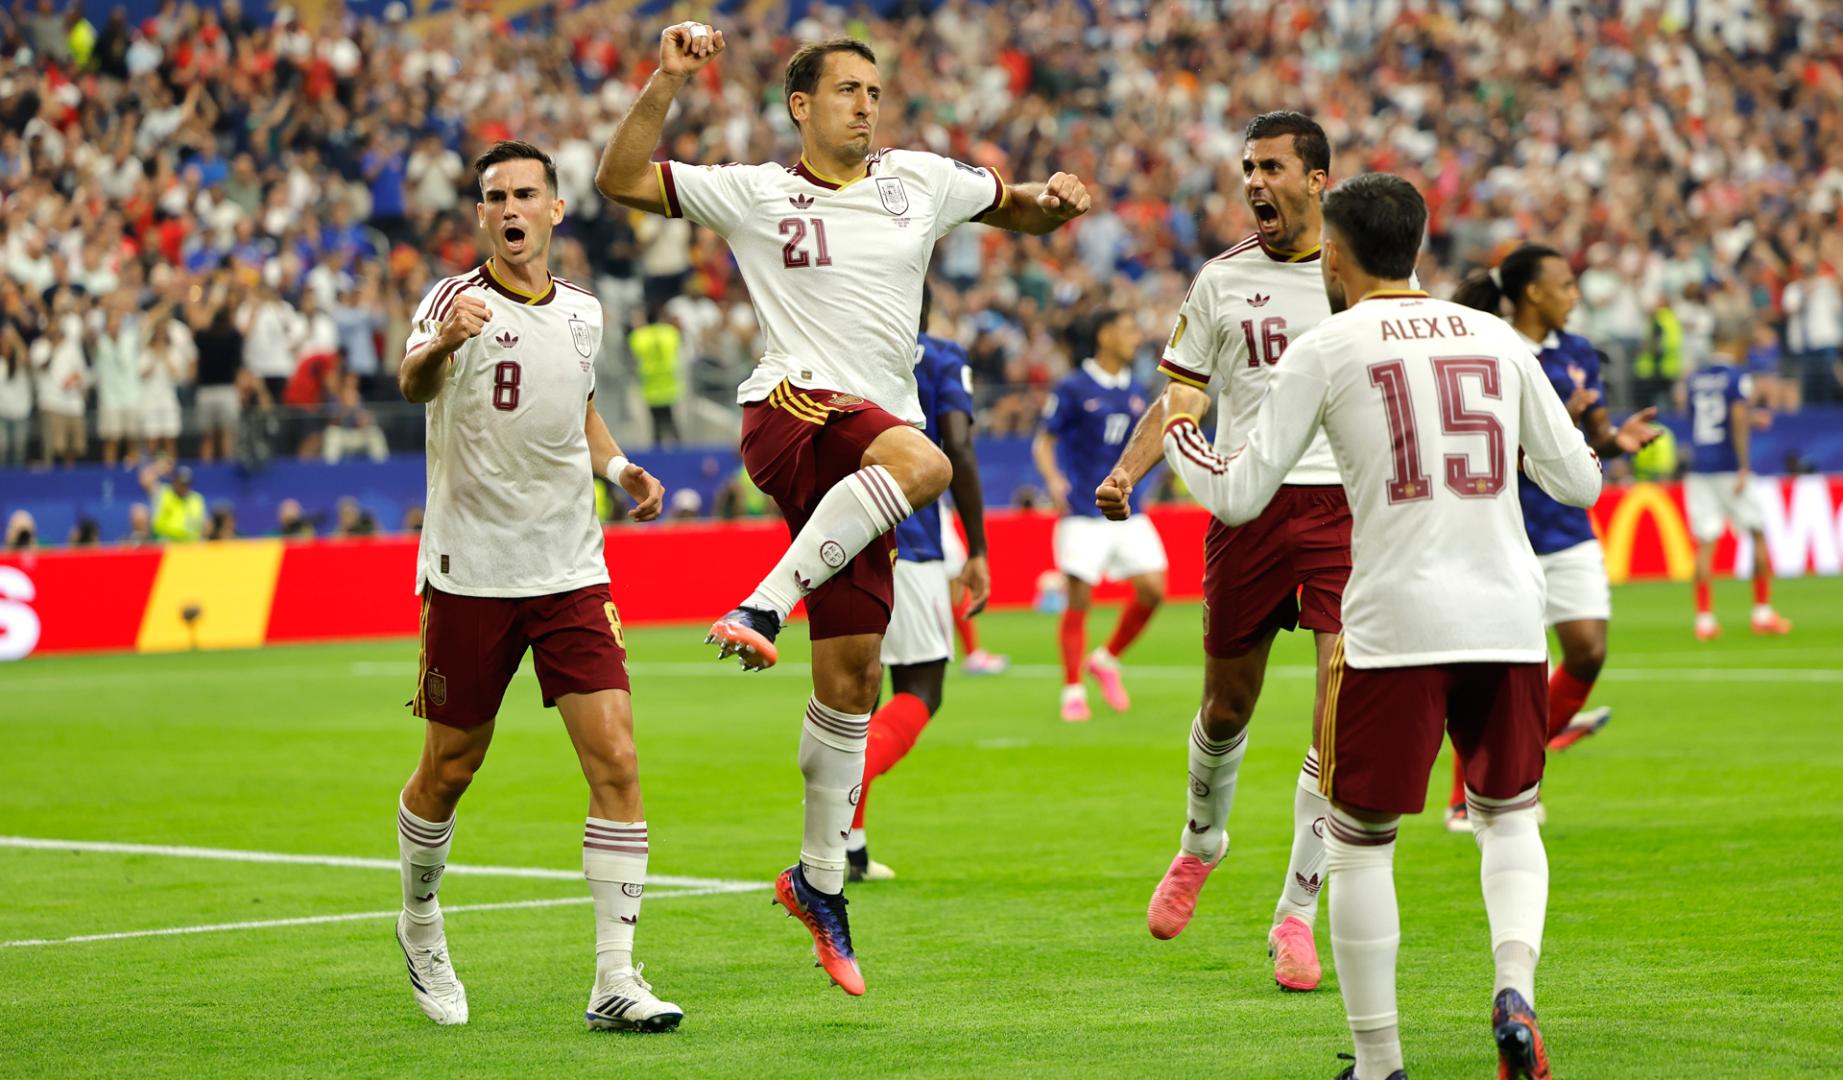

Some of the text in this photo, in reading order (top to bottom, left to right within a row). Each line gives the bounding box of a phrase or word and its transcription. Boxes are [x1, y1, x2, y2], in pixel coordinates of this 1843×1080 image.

[778, 217, 832, 269] 21
[1240, 316, 1288, 368] 16
[1381, 315, 1475, 341] ALEX B.
[493, 360, 522, 412] 8
[1103, 413, 1131, 445] 17
[1367, 355, 1507, 506] 15
[603, 601, 626, 649] 8
